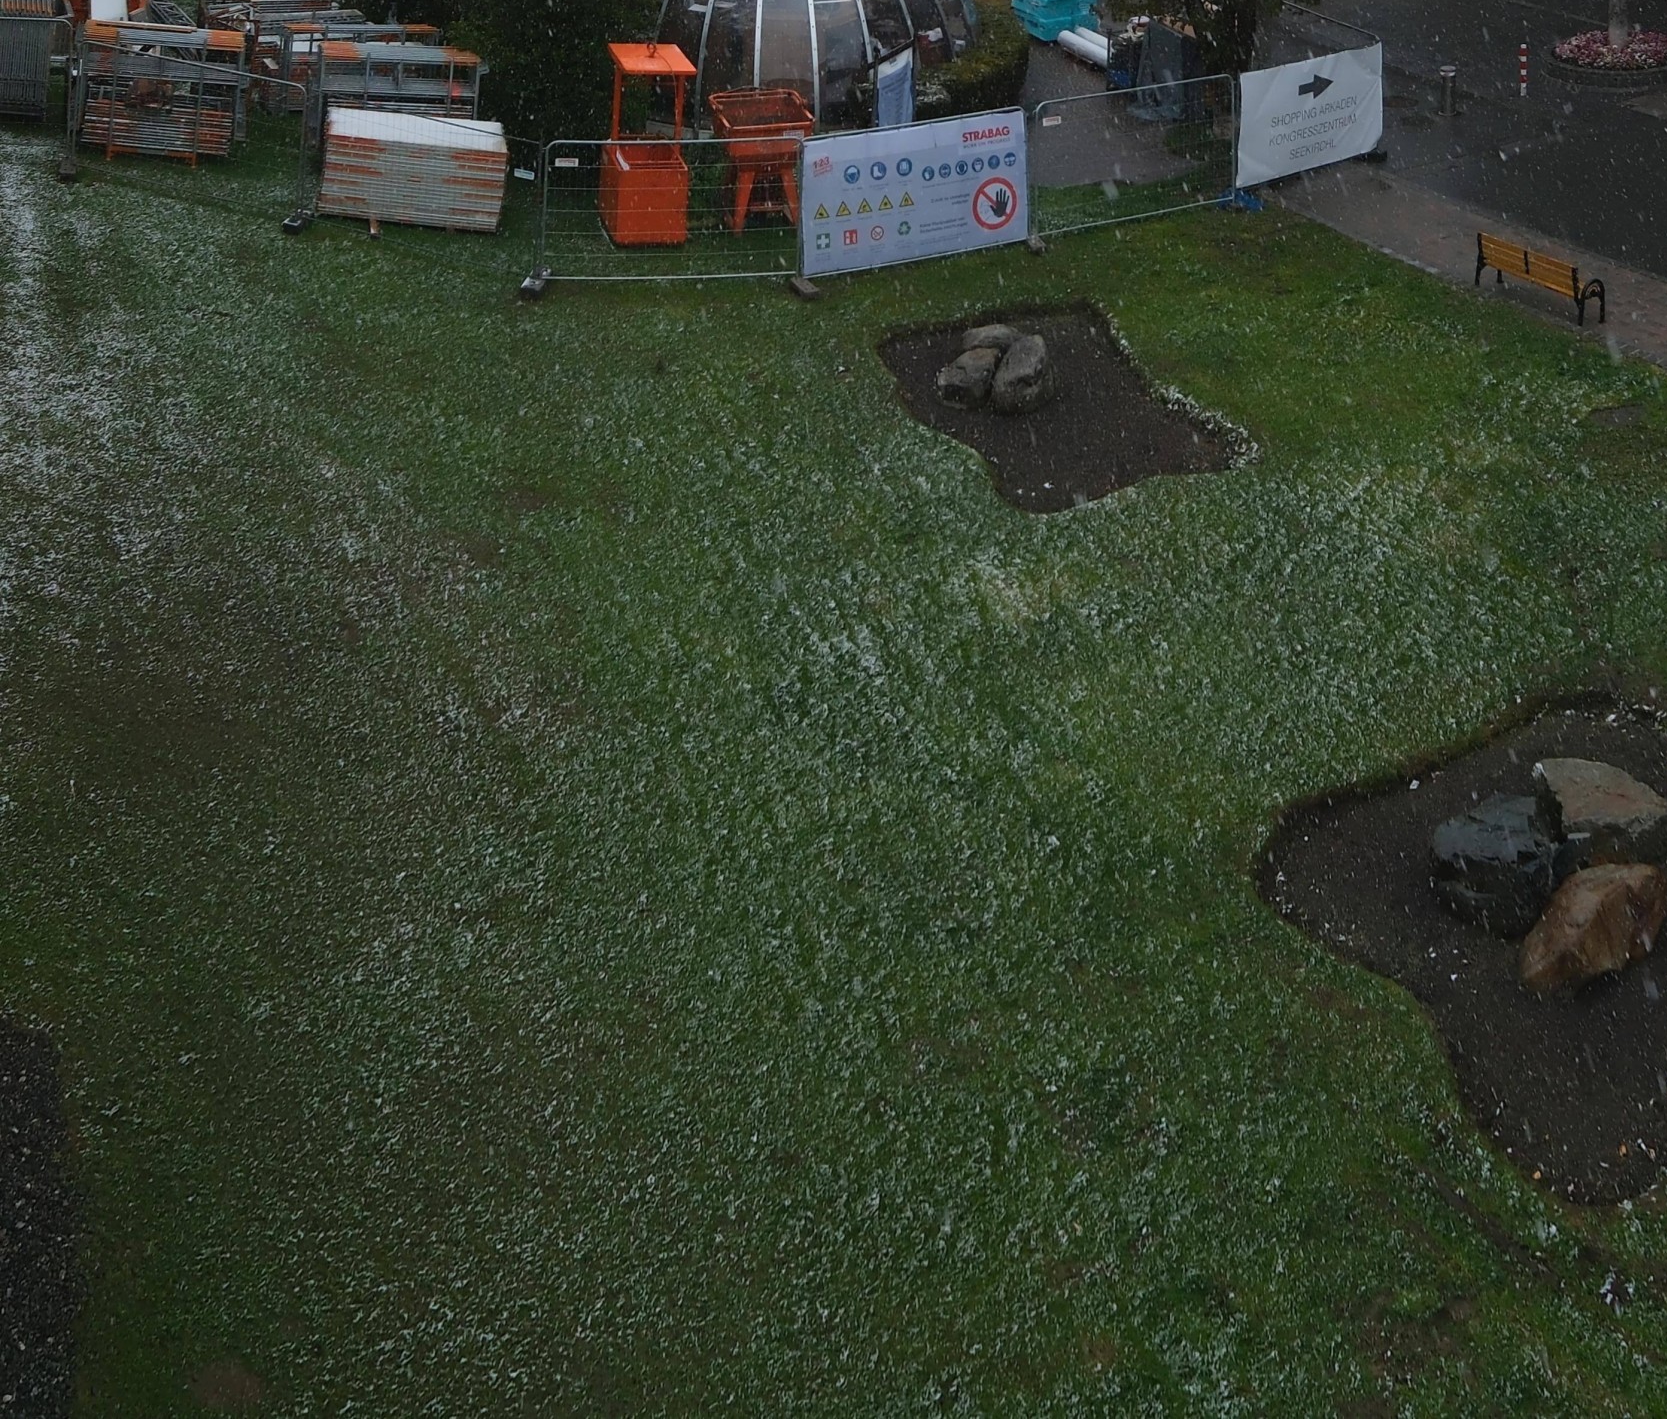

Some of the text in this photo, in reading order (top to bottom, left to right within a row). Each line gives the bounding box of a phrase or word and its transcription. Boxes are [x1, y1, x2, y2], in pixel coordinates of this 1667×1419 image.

[1271, 96, 1358, 128] SHOPPING ARKADEN
[962, 126, 1010, 143] STRABAG
[1269, 113, 1357, 146] KONGRESSZENTRUM
[1289, 139, 1337, 160] SEEKIRCHL
